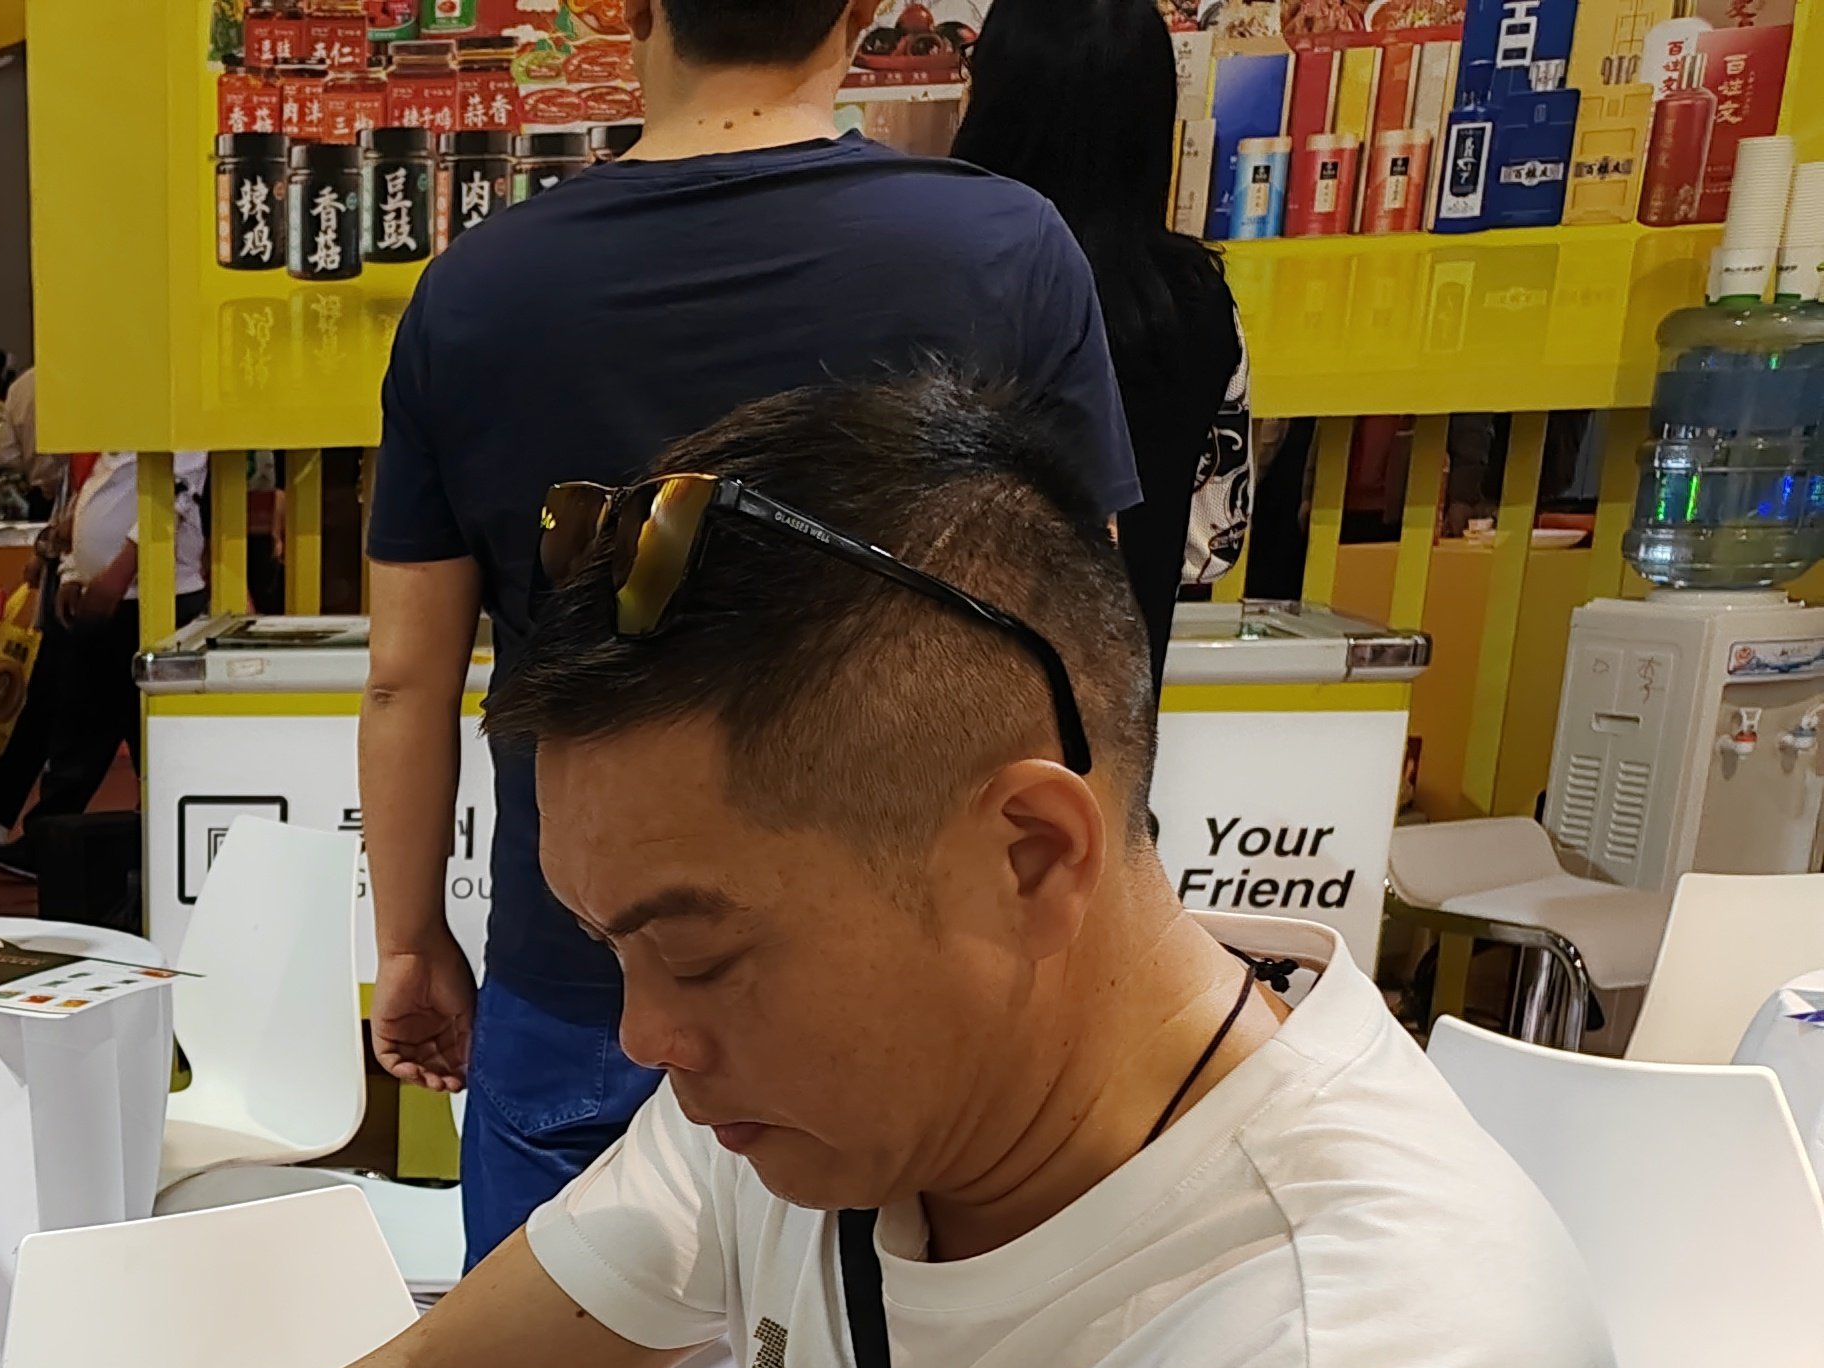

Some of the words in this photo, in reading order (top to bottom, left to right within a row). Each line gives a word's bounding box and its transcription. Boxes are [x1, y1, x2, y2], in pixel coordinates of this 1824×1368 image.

[237, 176, 273, 263] 辣鸡
[308, 186, 347, 273] 香菇
[377, 167, 417, 250] 豆豉
[1206, 817, 1335, 857] Your
[1177, 868, 1356, 908] Friend
